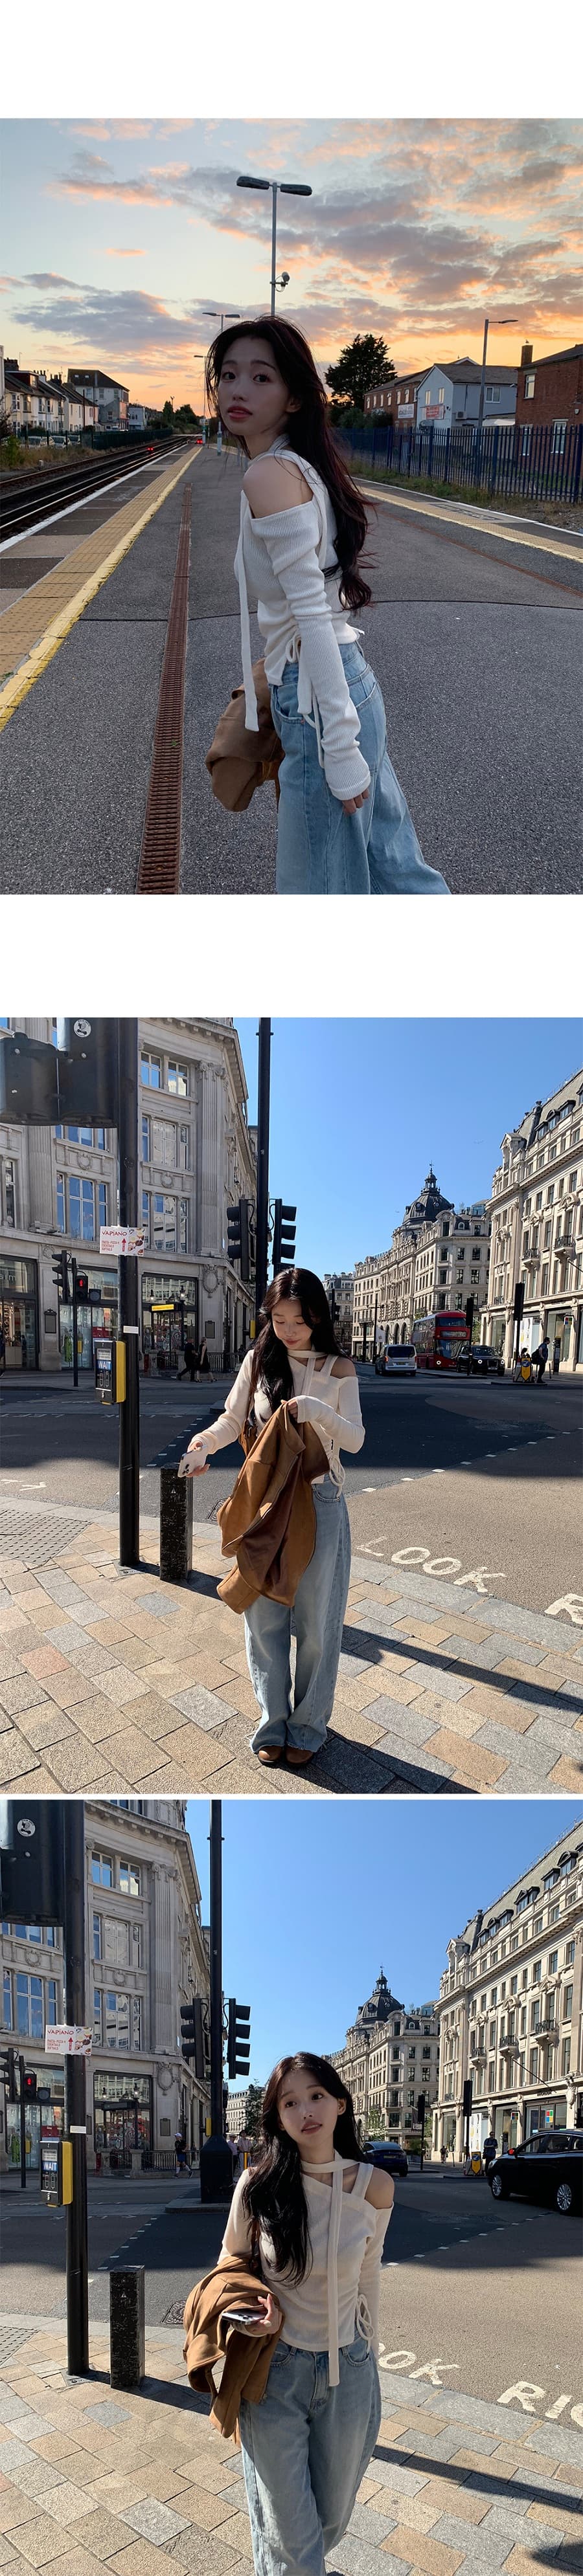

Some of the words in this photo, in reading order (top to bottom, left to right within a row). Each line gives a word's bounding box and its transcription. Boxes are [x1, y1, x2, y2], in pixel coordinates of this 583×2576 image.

[98, 1360, 111, 1370] WAIT
[356, 1536, 507, 1593] LOOK
[43, 2162, 57, 2171] WAIT
[378, 2342, 461, 2385] OK
